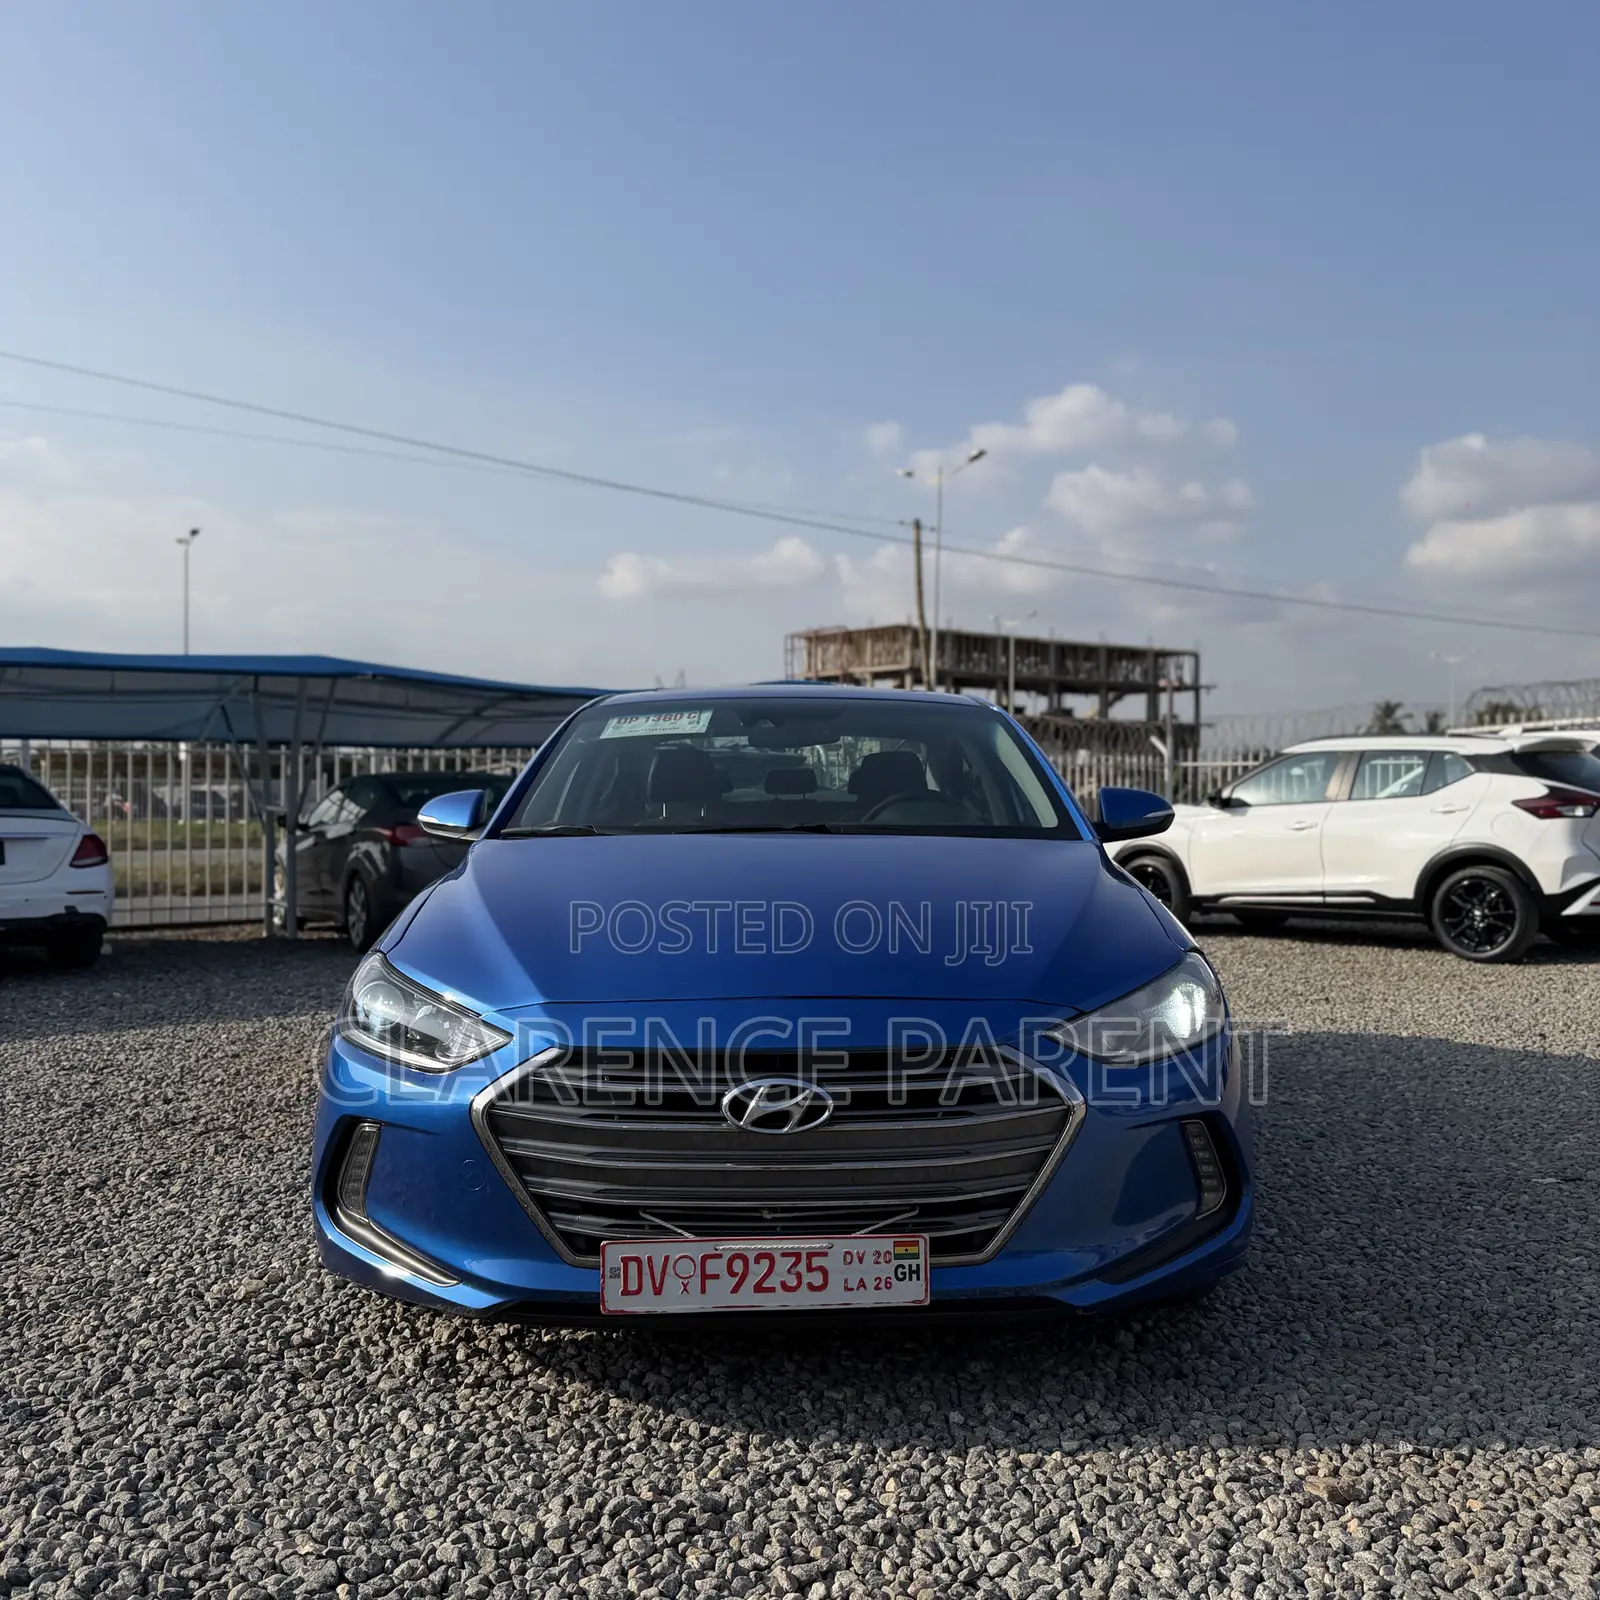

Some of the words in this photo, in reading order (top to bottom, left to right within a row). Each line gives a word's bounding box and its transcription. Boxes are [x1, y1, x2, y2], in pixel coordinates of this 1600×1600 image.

[842, 1249, 866, 1266] DV
[872, 1249, 893, 1265] 20
[619, 1254, 670, 1296] DV
[699, 1251, 829, 1295] F9235
[894, 1263, 921, 1282] GH
[843, 1276, 867, 1292] LA
[873, 1276, 893, 1291] 26
